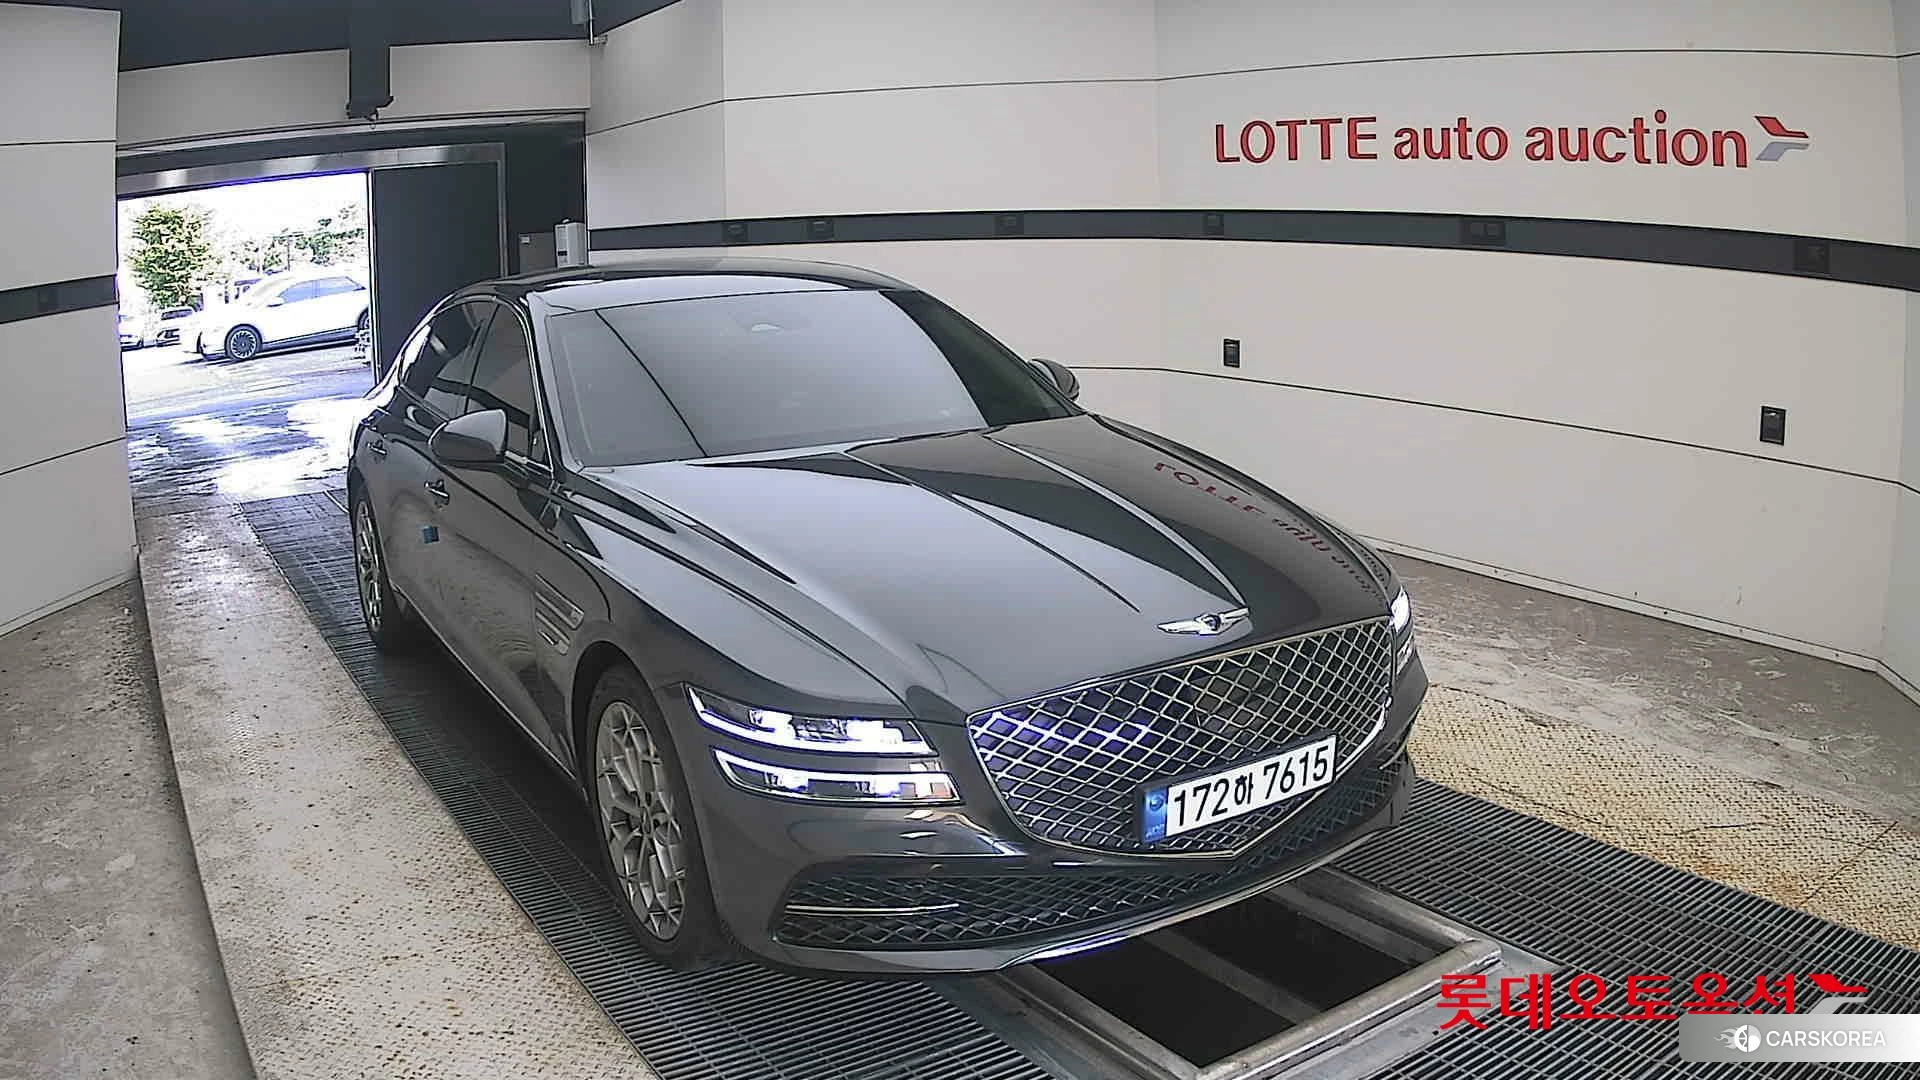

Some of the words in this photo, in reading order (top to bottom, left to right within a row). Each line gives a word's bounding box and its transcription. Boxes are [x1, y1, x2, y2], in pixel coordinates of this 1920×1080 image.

[1215, 116, 1377, 164] LOTTE
[1393, 116, 1512, 162] auto
[1524, 110, 1750, 169] auction
[1174, 772, 1254, 827] 172하
[1263, 746, 1329, 800] 7615
